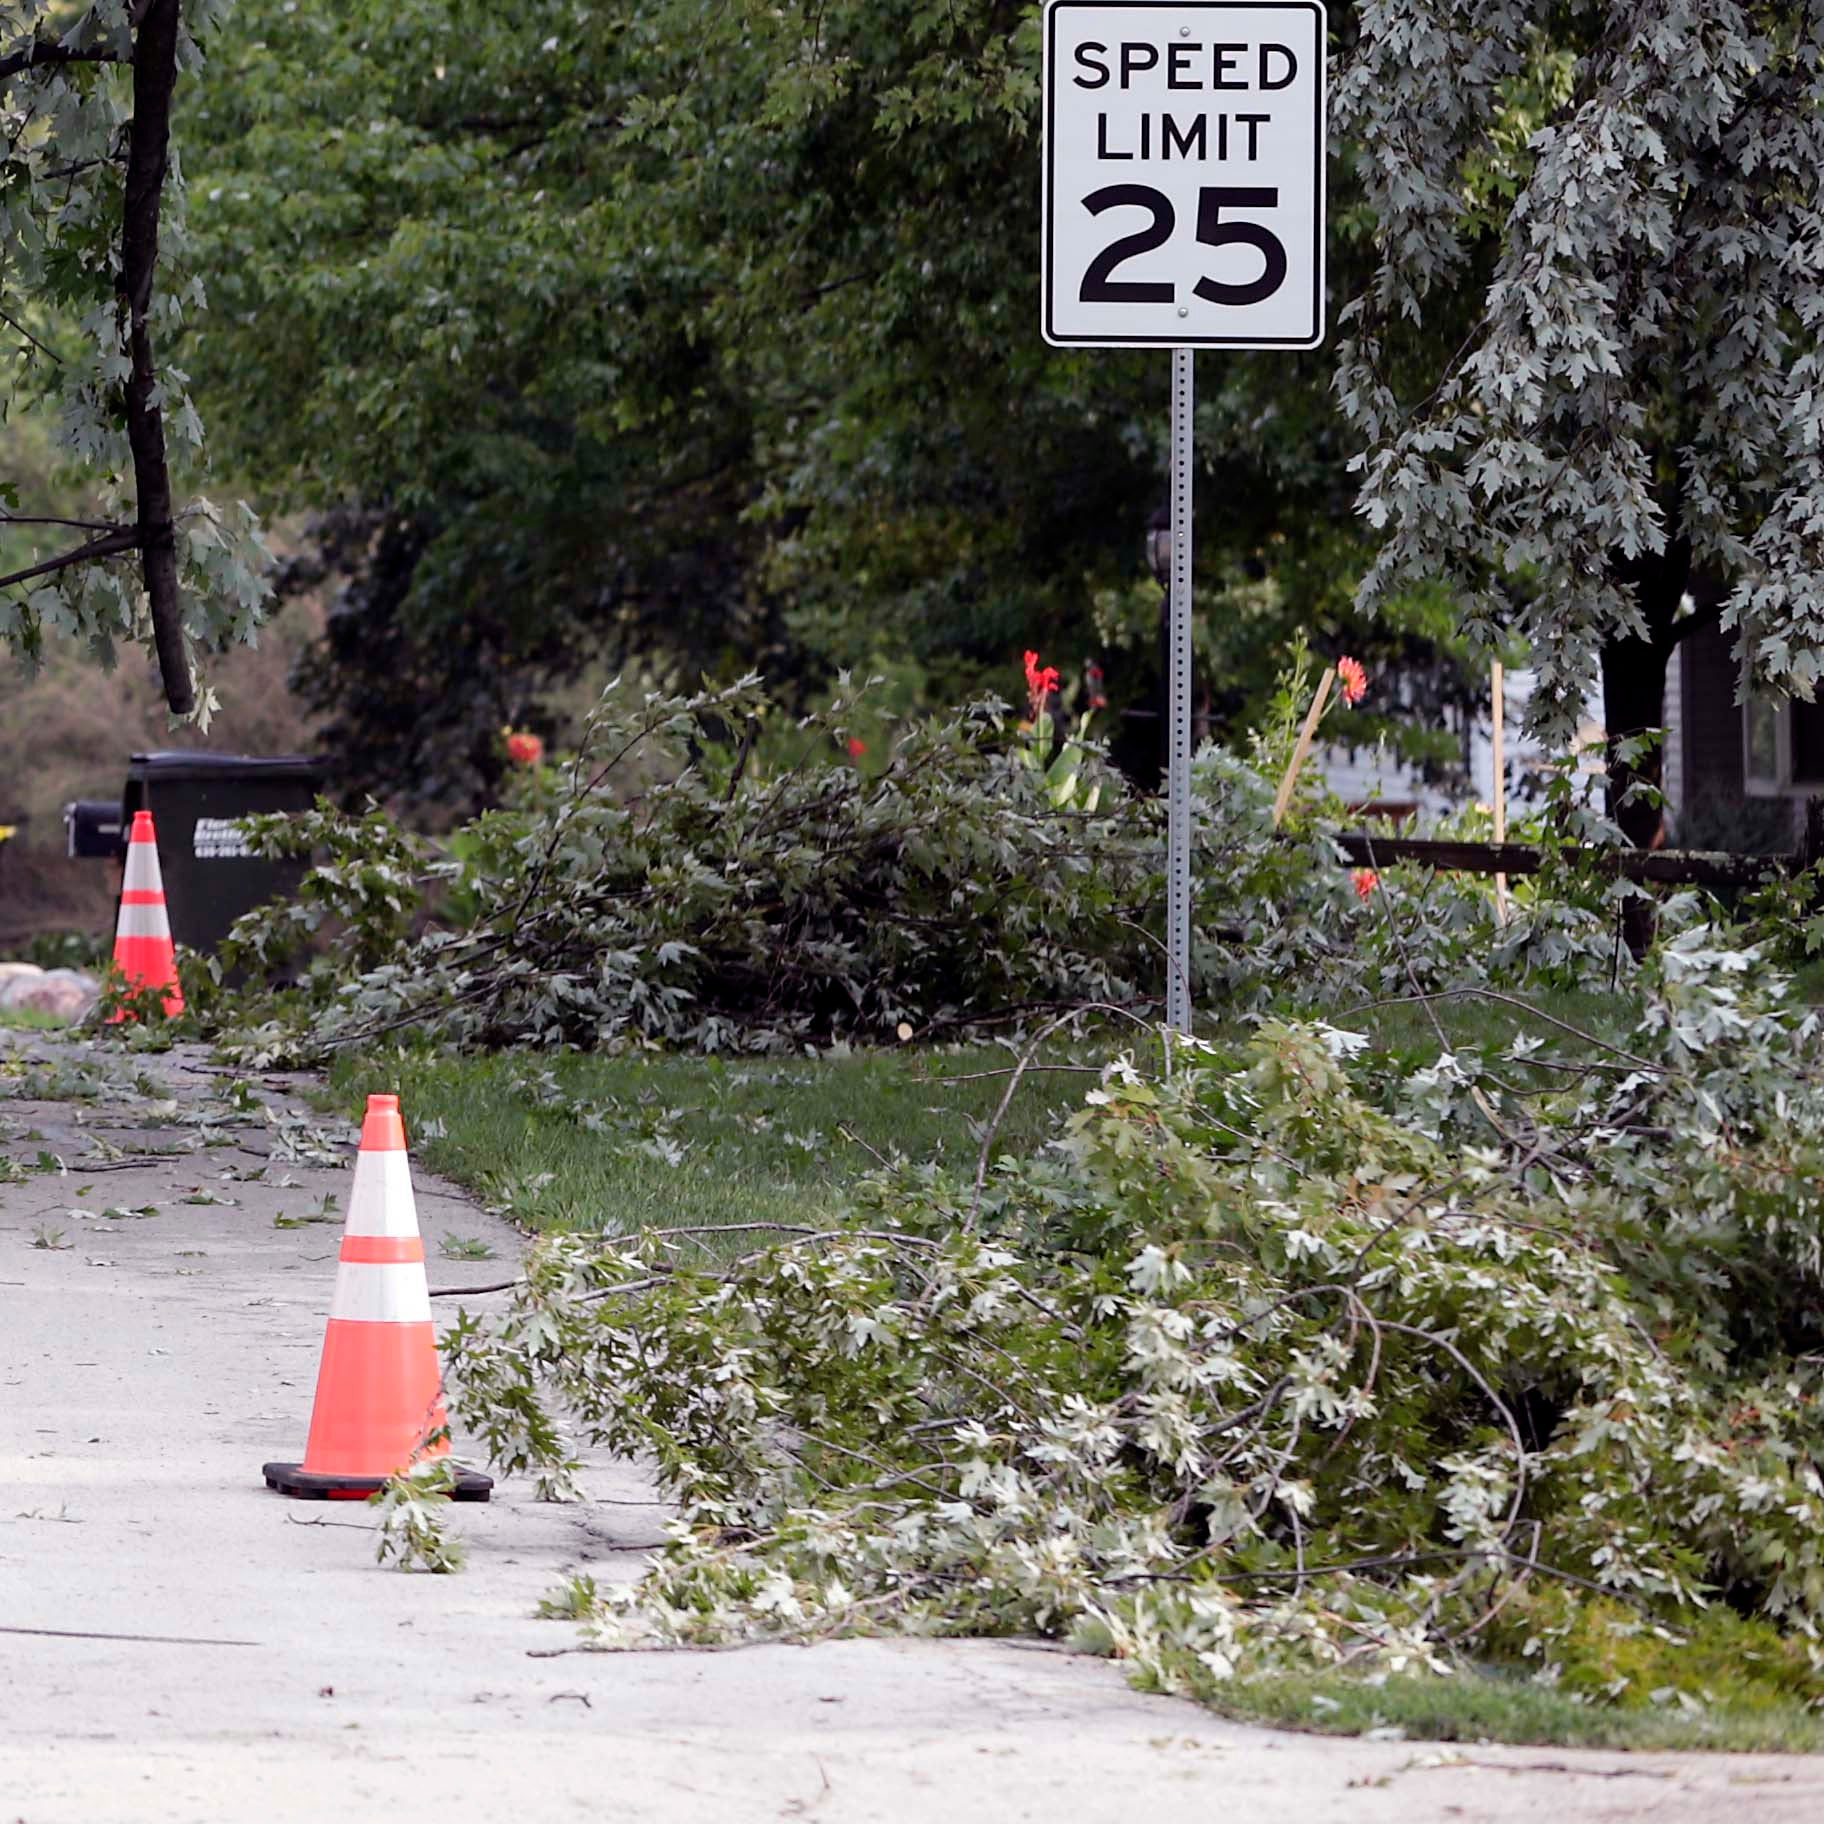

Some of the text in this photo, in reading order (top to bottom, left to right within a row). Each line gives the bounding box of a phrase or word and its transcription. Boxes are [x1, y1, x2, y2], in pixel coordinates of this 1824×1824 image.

[1073, 41, 1298, 90] SPEED
[1097, 112, 1271, 161] LIMIT
[1079, 183, 1288, 306] 25
